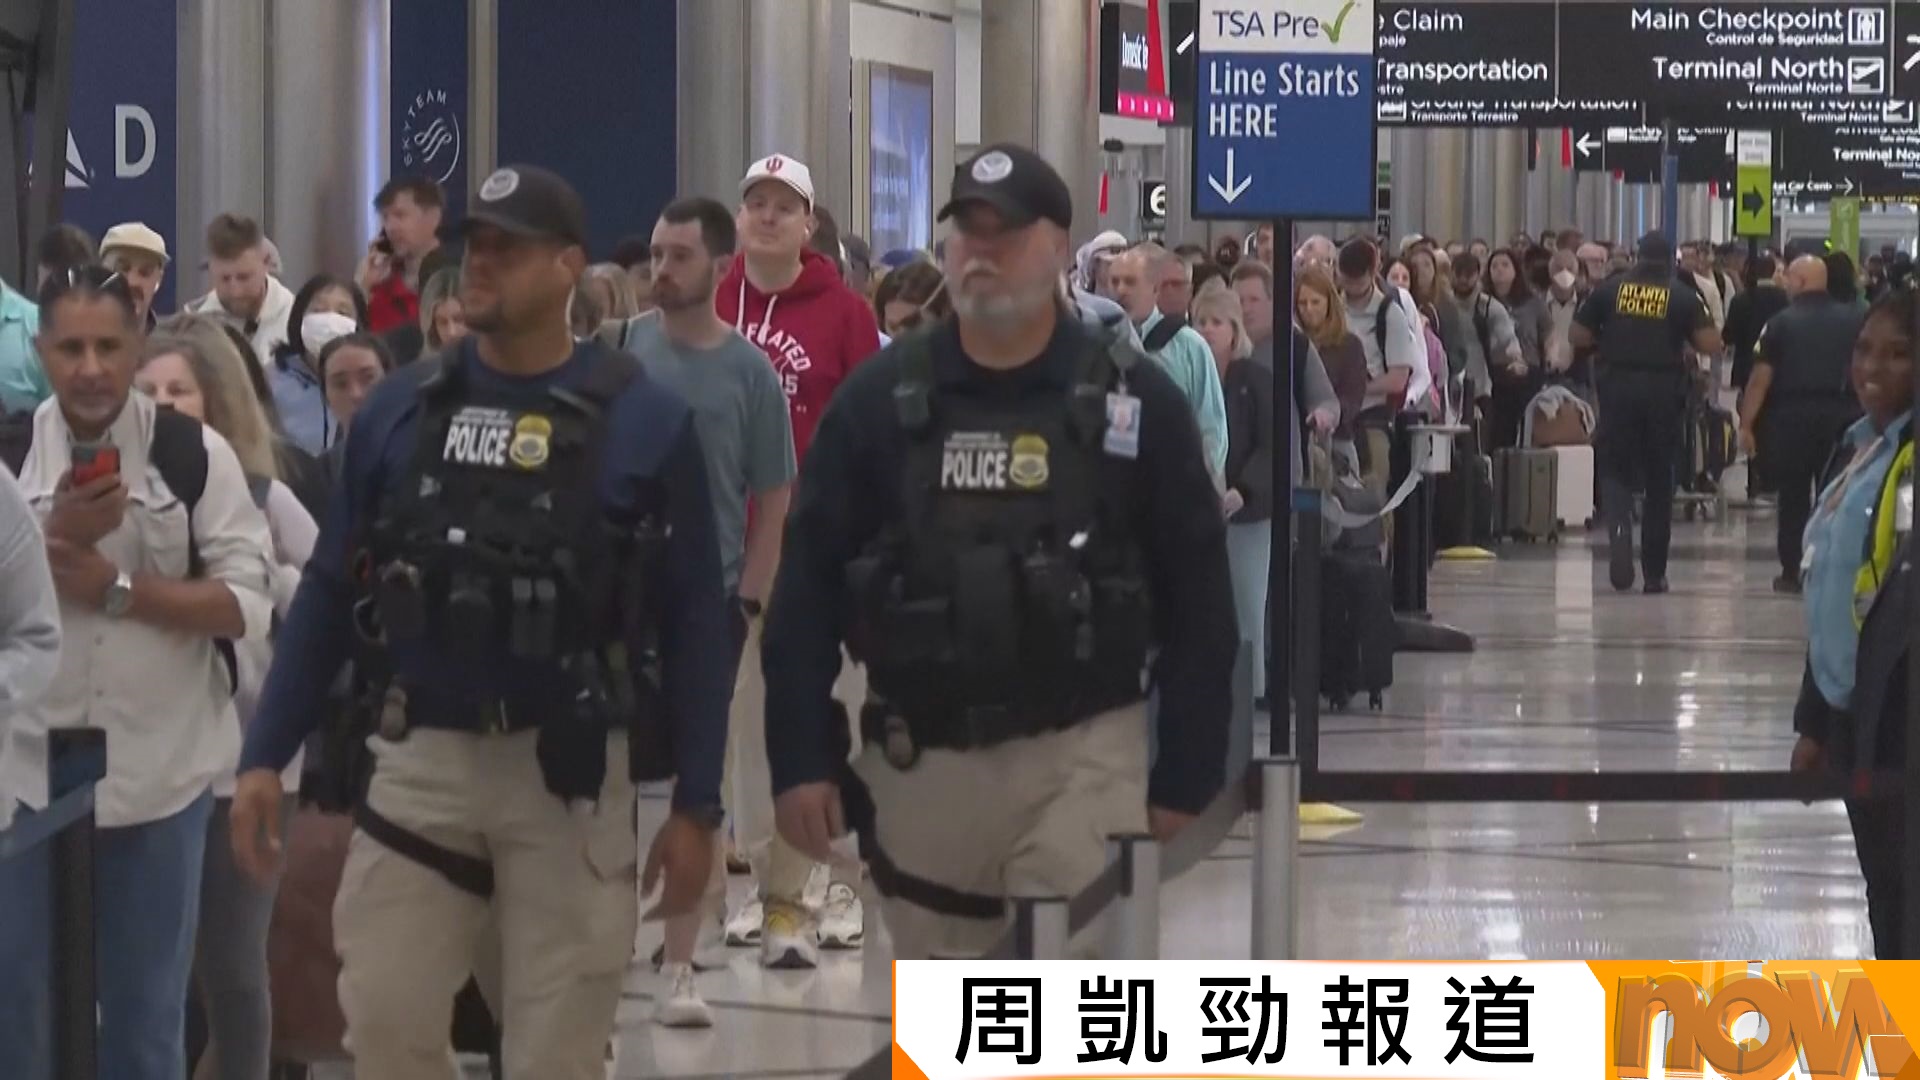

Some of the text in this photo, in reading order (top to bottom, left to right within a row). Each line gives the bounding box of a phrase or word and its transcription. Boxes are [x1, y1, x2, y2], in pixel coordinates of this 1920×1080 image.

[1212, 10, 1319, 38] TSA Pre
[1393, 8, 1463, 31] Claim
[1631, 8, 1844, 35] Main Checkpoint
[1705, 33, 1844, 47] Control de Seguridad
[1210, 60, 1360, 97] Line Starts
[1377, 57, 1548, 86] Transportation
[1653, 56, 1844, 80] Terminal North
[1748, 82, 1843, 95] Terminal Norte
[1209, 102, 1278, 138] HERE
[1411, 110, 1519, 123] Transporte Terrestre
[1801, 111, 1880, 123] Terminal Norte
[115, 103, 157, 178] D
[1833, 146, 1893, 161] Terminal
[1620, 283, 1668, 303] ATLANTA
[1618, 298, 1666, 317] POLICE
[746, 322, 812, 372] FATED
[442, 423, 511, 467] POLICE
[941, 450, 1009, 489] POLICE
